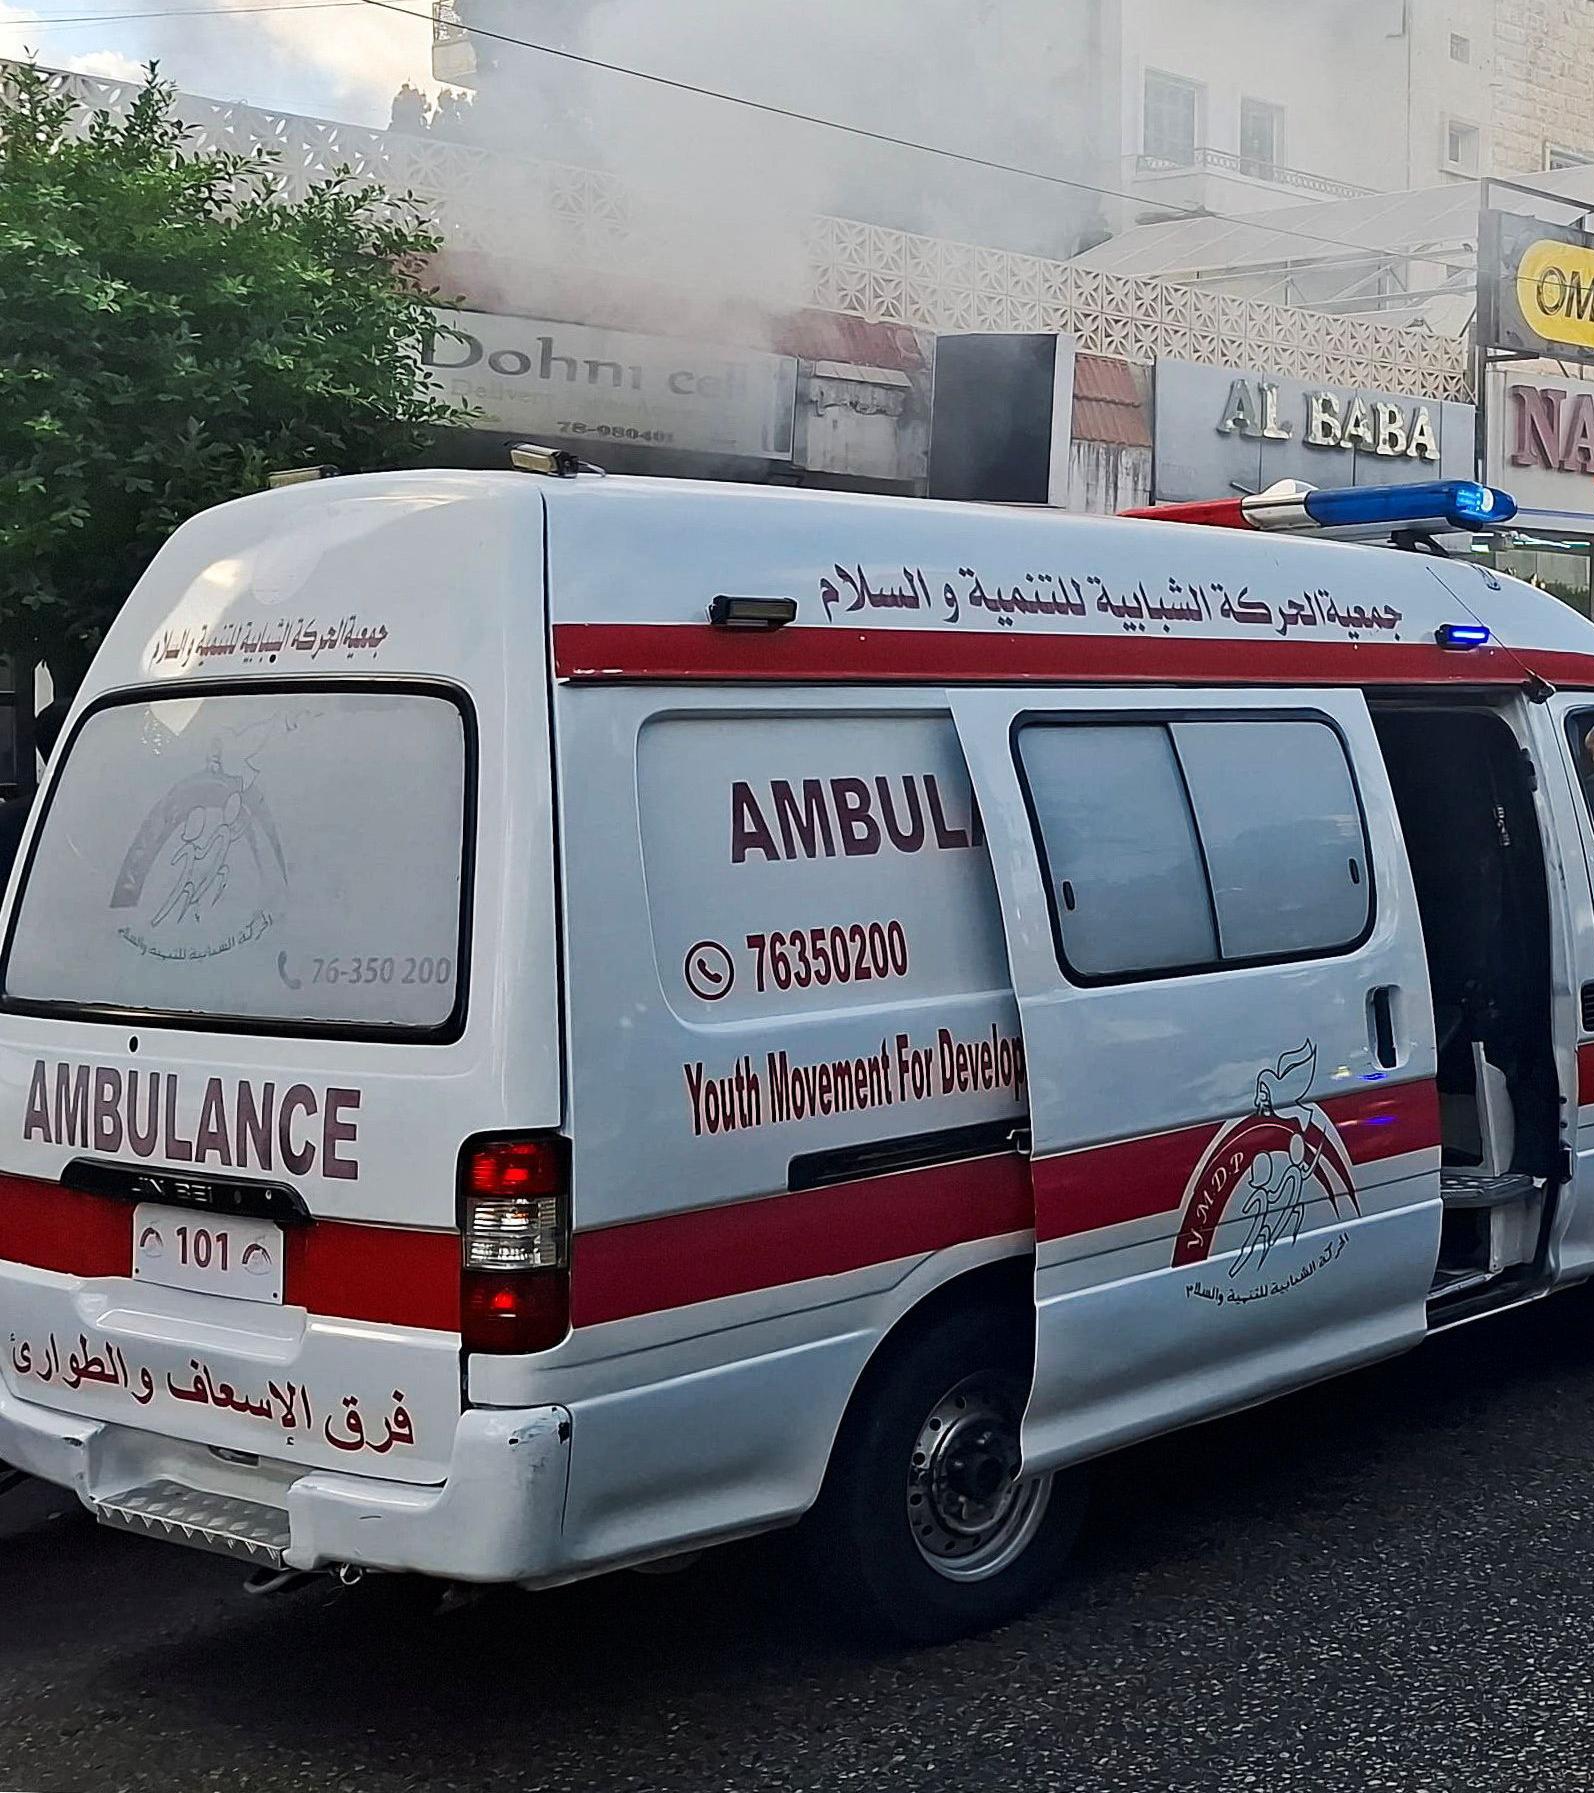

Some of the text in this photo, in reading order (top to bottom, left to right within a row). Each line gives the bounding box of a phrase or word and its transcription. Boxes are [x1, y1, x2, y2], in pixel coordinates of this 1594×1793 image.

[420, 328, 642, 391] Dohni
[1216, 378, 1441, 461] AL BABA
[819, 562, 933, 624] السلام
[958, 567, 1087, 627] للتنمية
[1086, 576, 1213, 633] الشبابية
[730, 774, 986, 864] AMBUL
[312, 957, 452, 985] 76-350 200
[746, 919, 908, 992] 76350200
[684, 1055, 762, 1136] Youth
[767, 1038, 893, 1123] Movement
[896, 1033, 934, 1102] For
[23, 1059, 361, 1180] AMBULANCE
[176, 1226, 229, 1271] 101
[167, 1358, 312, 1448] الإسعاف
[324, 1388, 415, 1454] فرق
